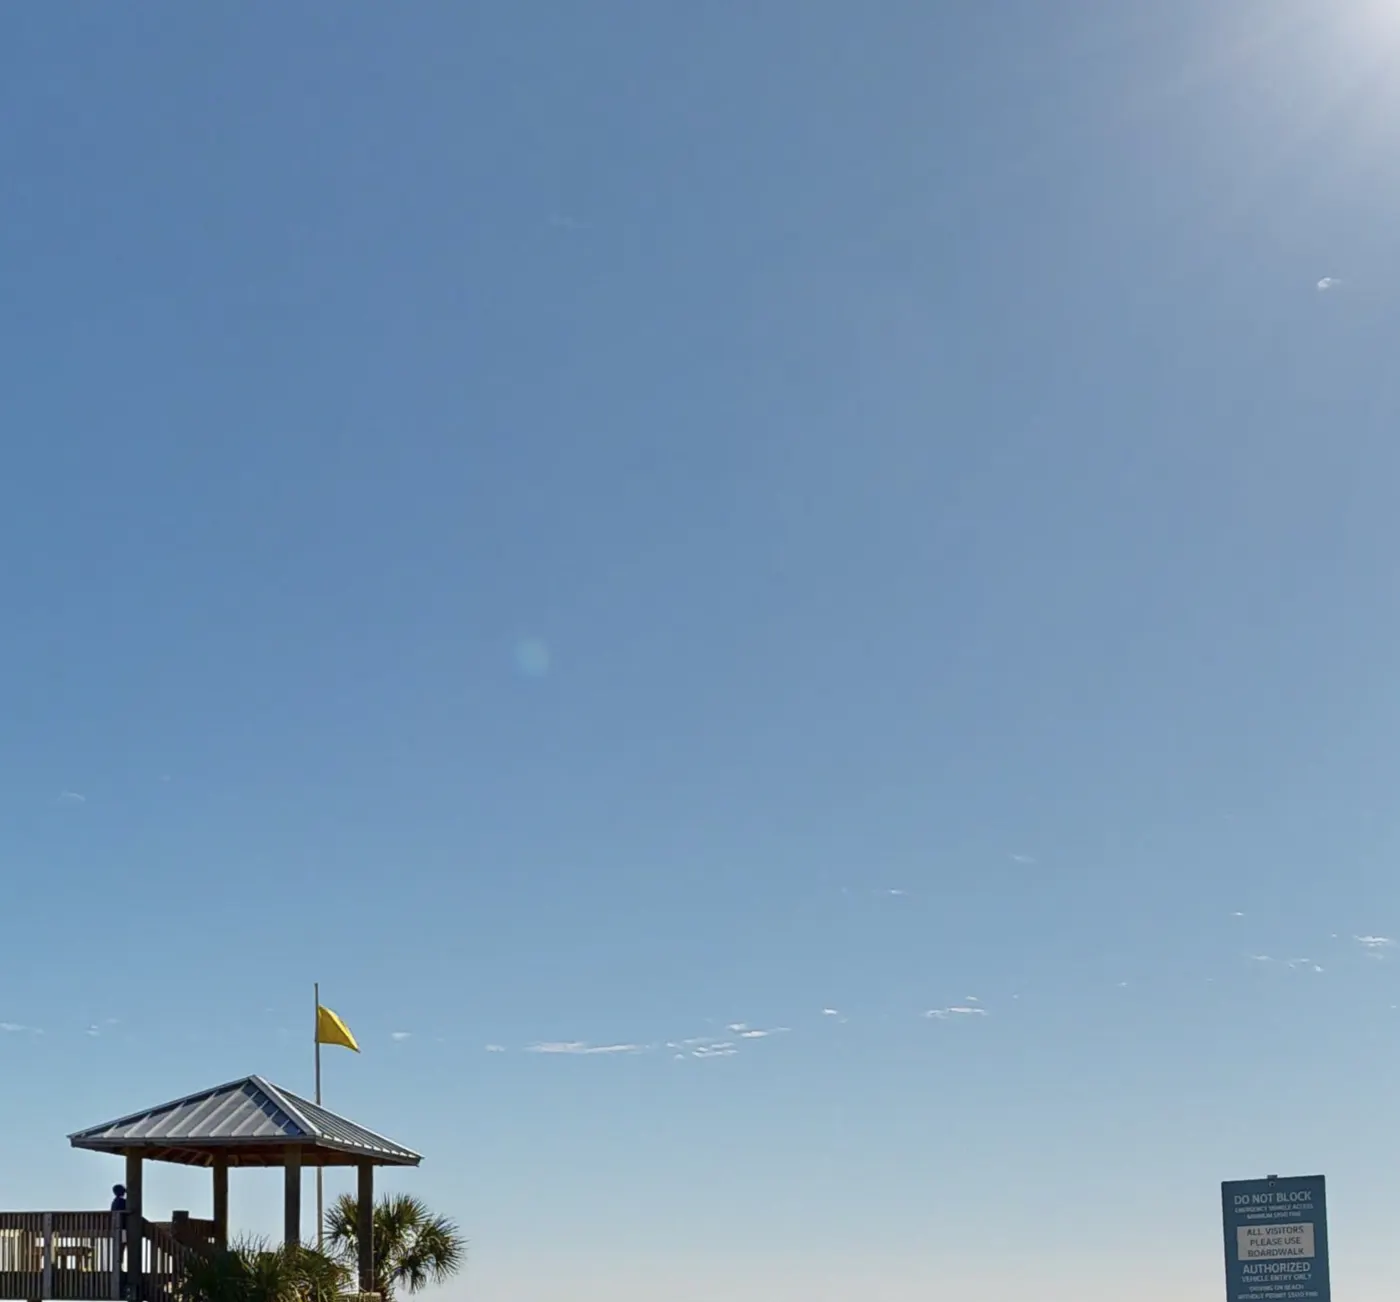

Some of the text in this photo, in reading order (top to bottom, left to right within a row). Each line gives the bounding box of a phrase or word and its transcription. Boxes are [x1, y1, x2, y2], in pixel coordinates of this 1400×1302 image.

[1234, 1190, 1312, 1205] DO NOT BLOCK
[1246, 1226, 1304, 1236] ALL VISITORS
[1250, 1236, 1302, 1246] PLEASE USE
[1247, 1248, 1304, 1258] BOARDWALK
[1242, 1262, 1311, 1274] AUTHORIZED
[1241, 1275, 1268, 1283] VEHICLE
